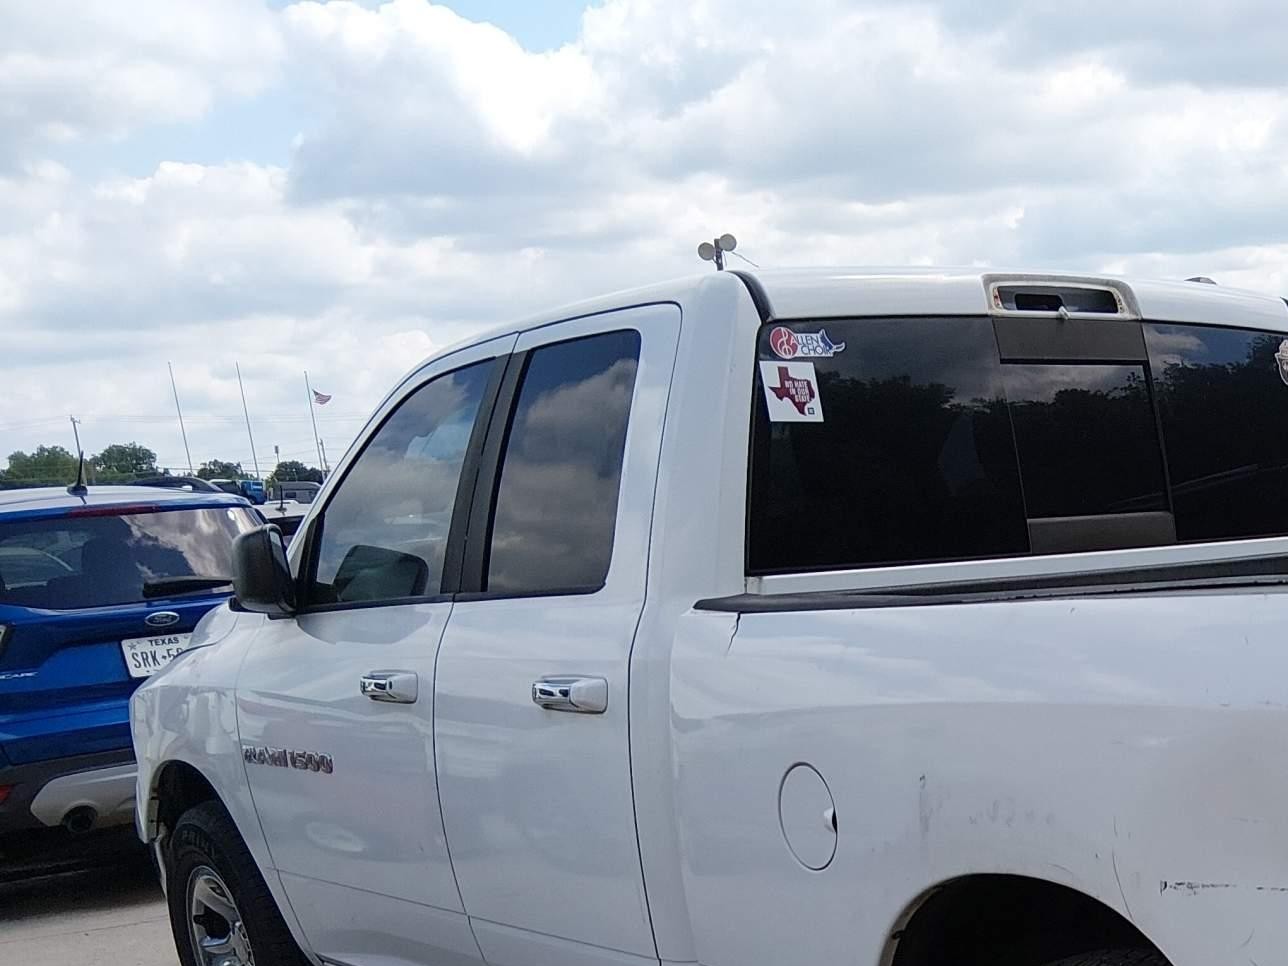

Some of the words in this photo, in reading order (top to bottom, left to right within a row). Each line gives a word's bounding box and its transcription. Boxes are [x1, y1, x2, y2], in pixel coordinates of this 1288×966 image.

[789, 335, 820, 346] ALLEN
[147, 636, 180, 647] TEXAS
[289, 750, 334, 774] 1500
